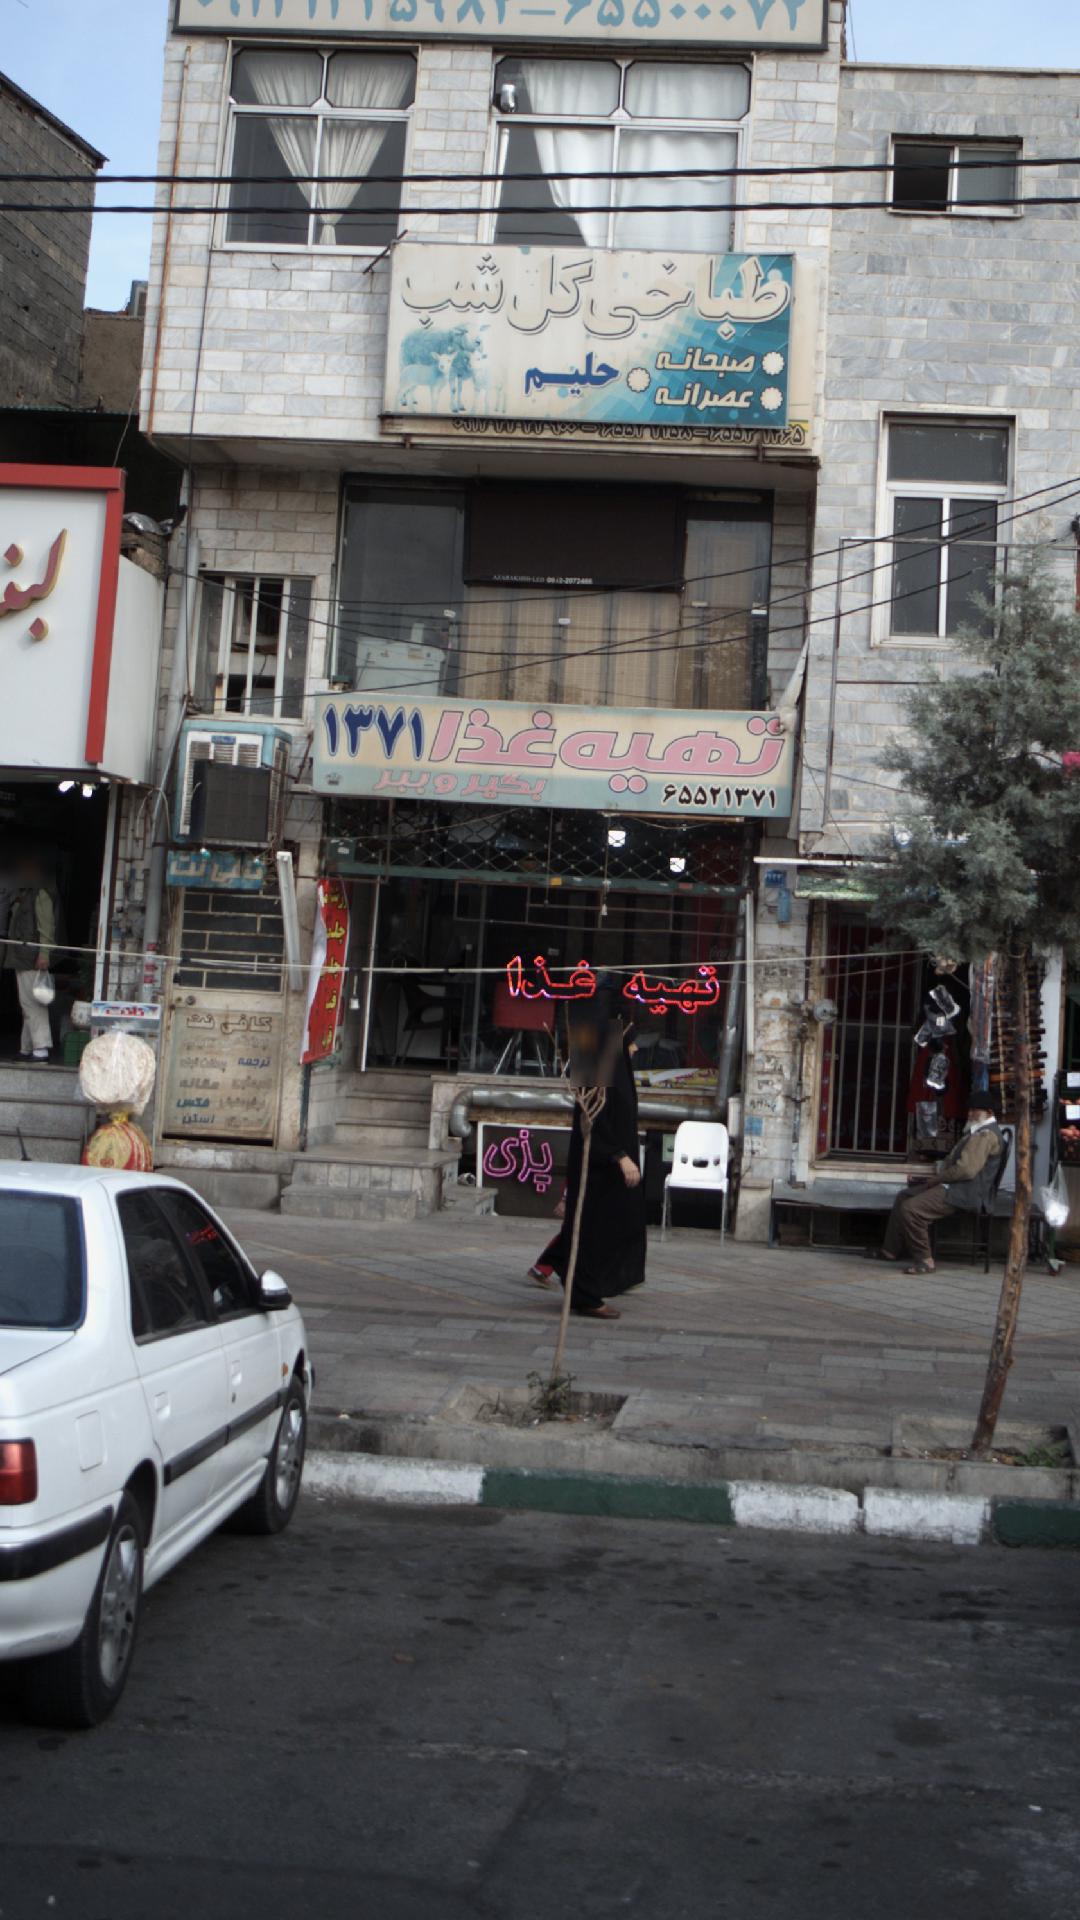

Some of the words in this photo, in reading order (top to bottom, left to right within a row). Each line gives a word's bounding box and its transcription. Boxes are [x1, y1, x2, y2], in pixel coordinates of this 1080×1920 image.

[400, 252, 505, 330] شب
[506, 253, 594, 336] گل
[582, 254, 792, 341] طباخی
[523, 352, 621, 395] حلیم
[654, 347, 756, 373] صبحانه
[654, 385, 755, 410] عصرانه
[322, 703, 423, 761] ۱۳۷۱
[427, 707, 558, 769] غذا
[559, 715, 786, 794] تهیه
[373, 769, 432, 795] ببر
[432, 772, 458, 795] و
[661, 783, 778, 809] ۶۵۵۲۱۳۷۱
[506, 955, 597, 999] غذا
[622, 964, 720, 1014] تهیه
[186, 1013, 216, 1030] نت
[220, 1013, 274, 1035] کافی
[238, 1056, 271, 1069] ترجمه
